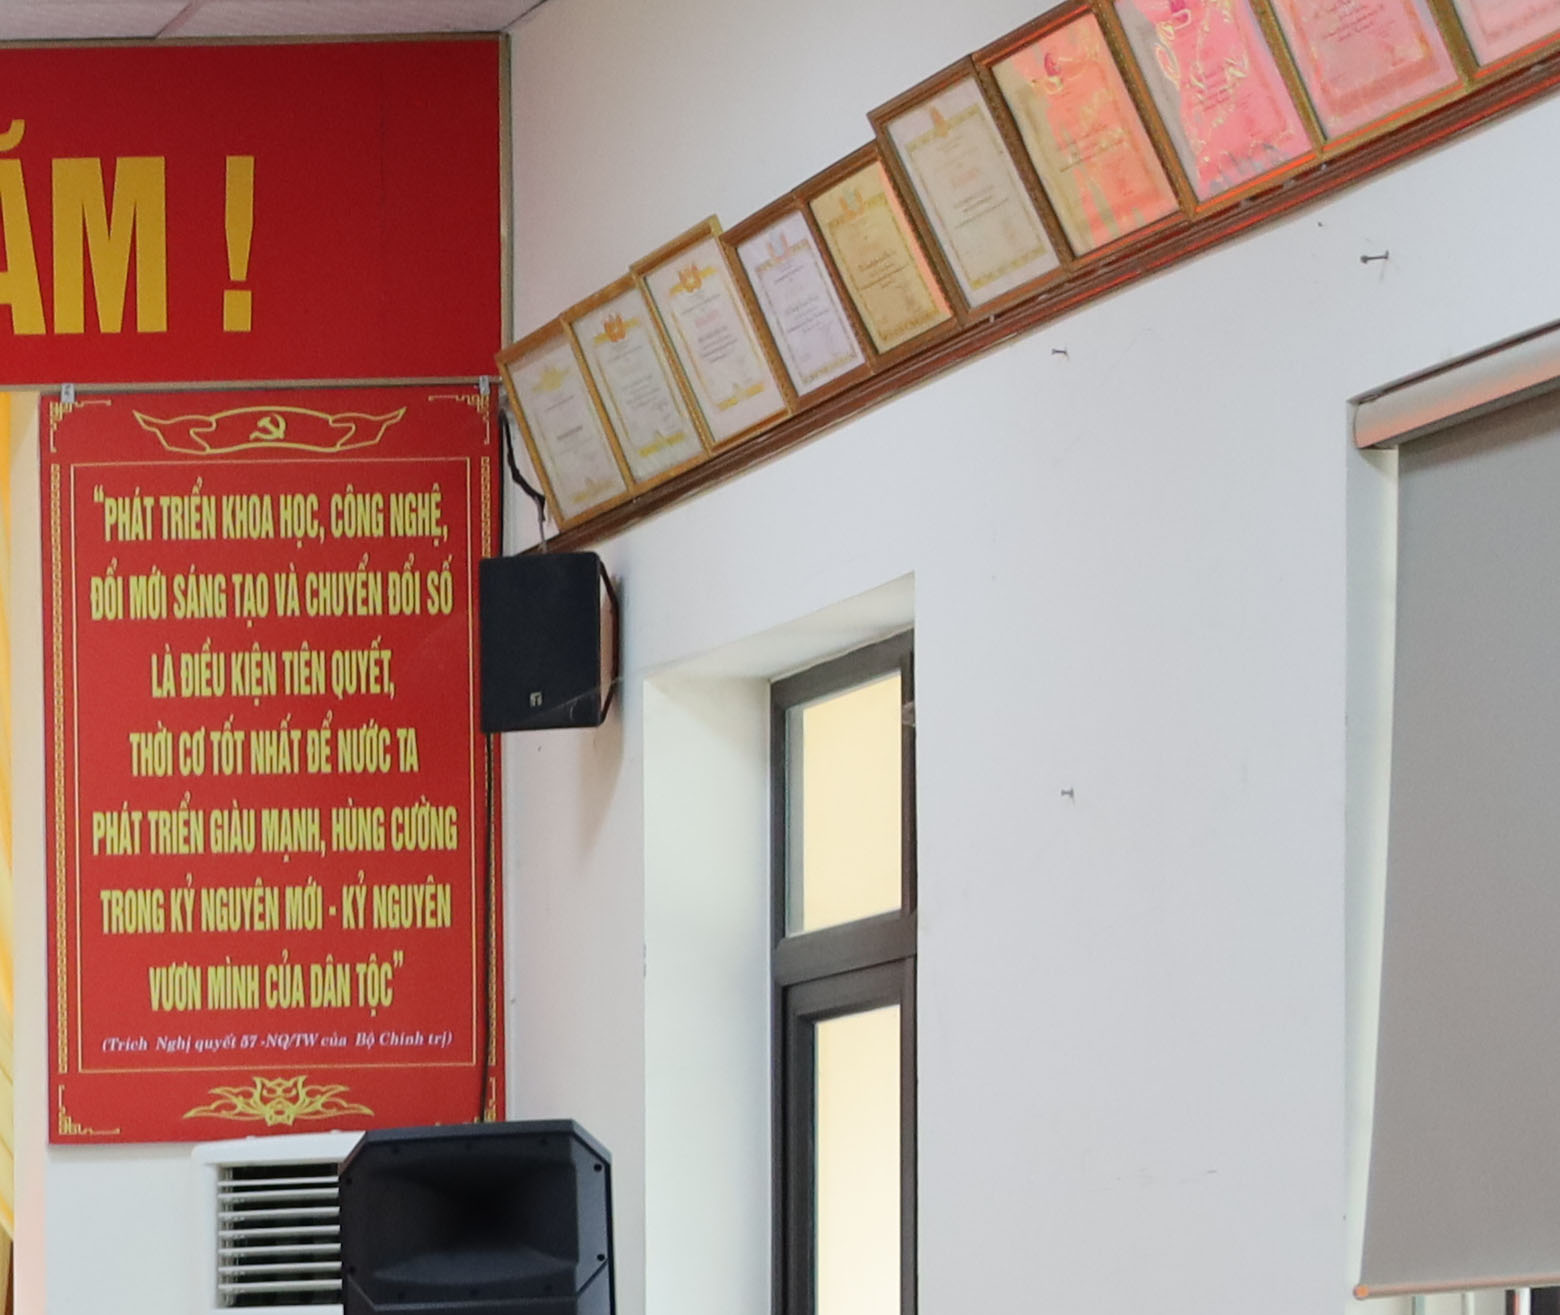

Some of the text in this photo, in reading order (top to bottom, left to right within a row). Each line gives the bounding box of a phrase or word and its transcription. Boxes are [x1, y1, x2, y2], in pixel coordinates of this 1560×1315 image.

[94, 477, 447, 548] “PHÁT TRIỂN KHOA HỌC, CÔNG NGHỆ,
[90, 553, 452, 627] ĐỔI MỚI SÁNG TẠO VÀ CHUYỂN ĐỔI SỐ
[152, 636, 394, 706] LÀ ĐIỀU KIỆN TIÊN QUYẾT,
[93, 792, 457, 862] PHÁT TRIỂN GIÀU MẠNH, HÙNG CƯỜNG
[149, 949, 403, 1016] VƯƠN MÌNH CỦA DÂN TỘC”
